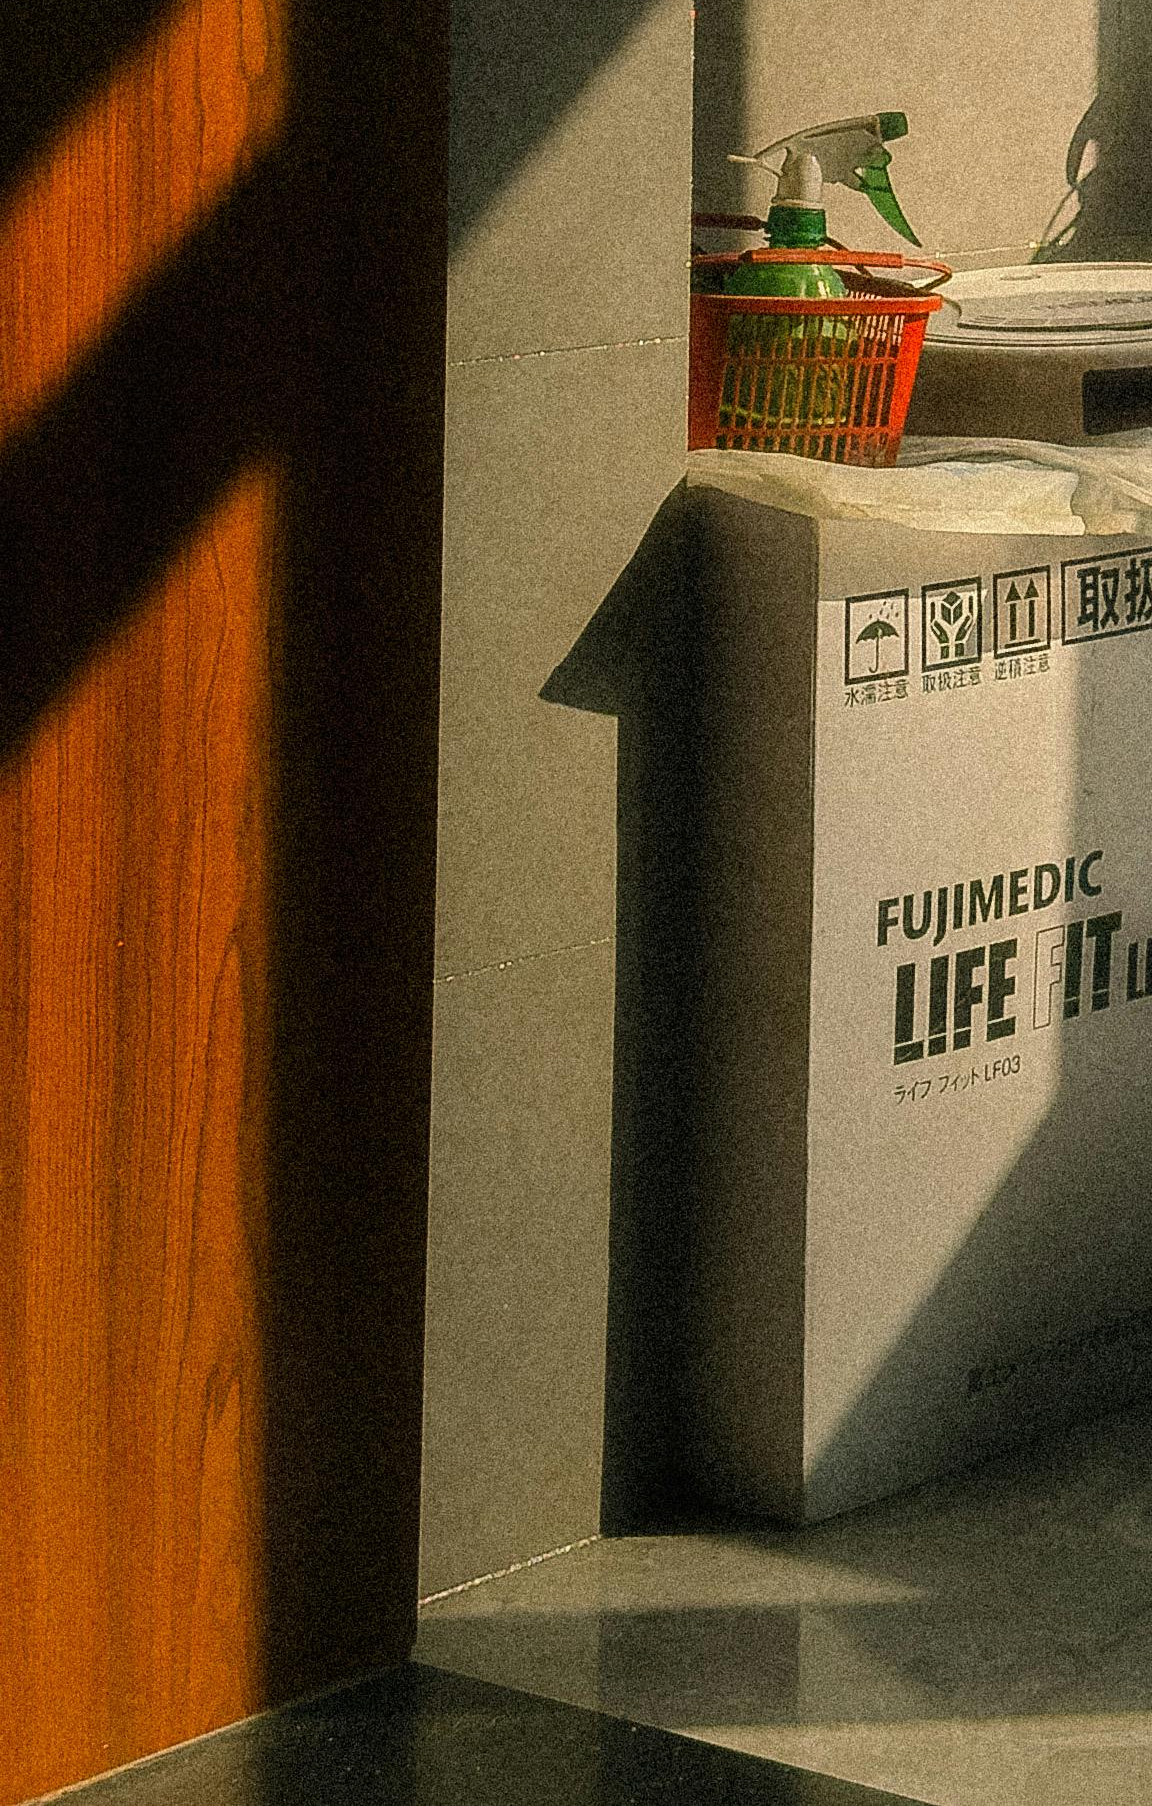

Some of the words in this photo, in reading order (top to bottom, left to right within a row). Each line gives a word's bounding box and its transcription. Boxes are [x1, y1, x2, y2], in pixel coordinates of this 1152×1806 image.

[922, 665, 982, 694] 取扱注意
[876, 850, 1104, 947] FUJIMEDIC
[893, 938, 1018, 1066] LIFE
[1033, 910, 1123, 1030] FIT
[893, 1079, 932, 1106] ライフ
[938, 1067, 981, 1094] フィット
[984, 1054, 1021, 1083] LF03
